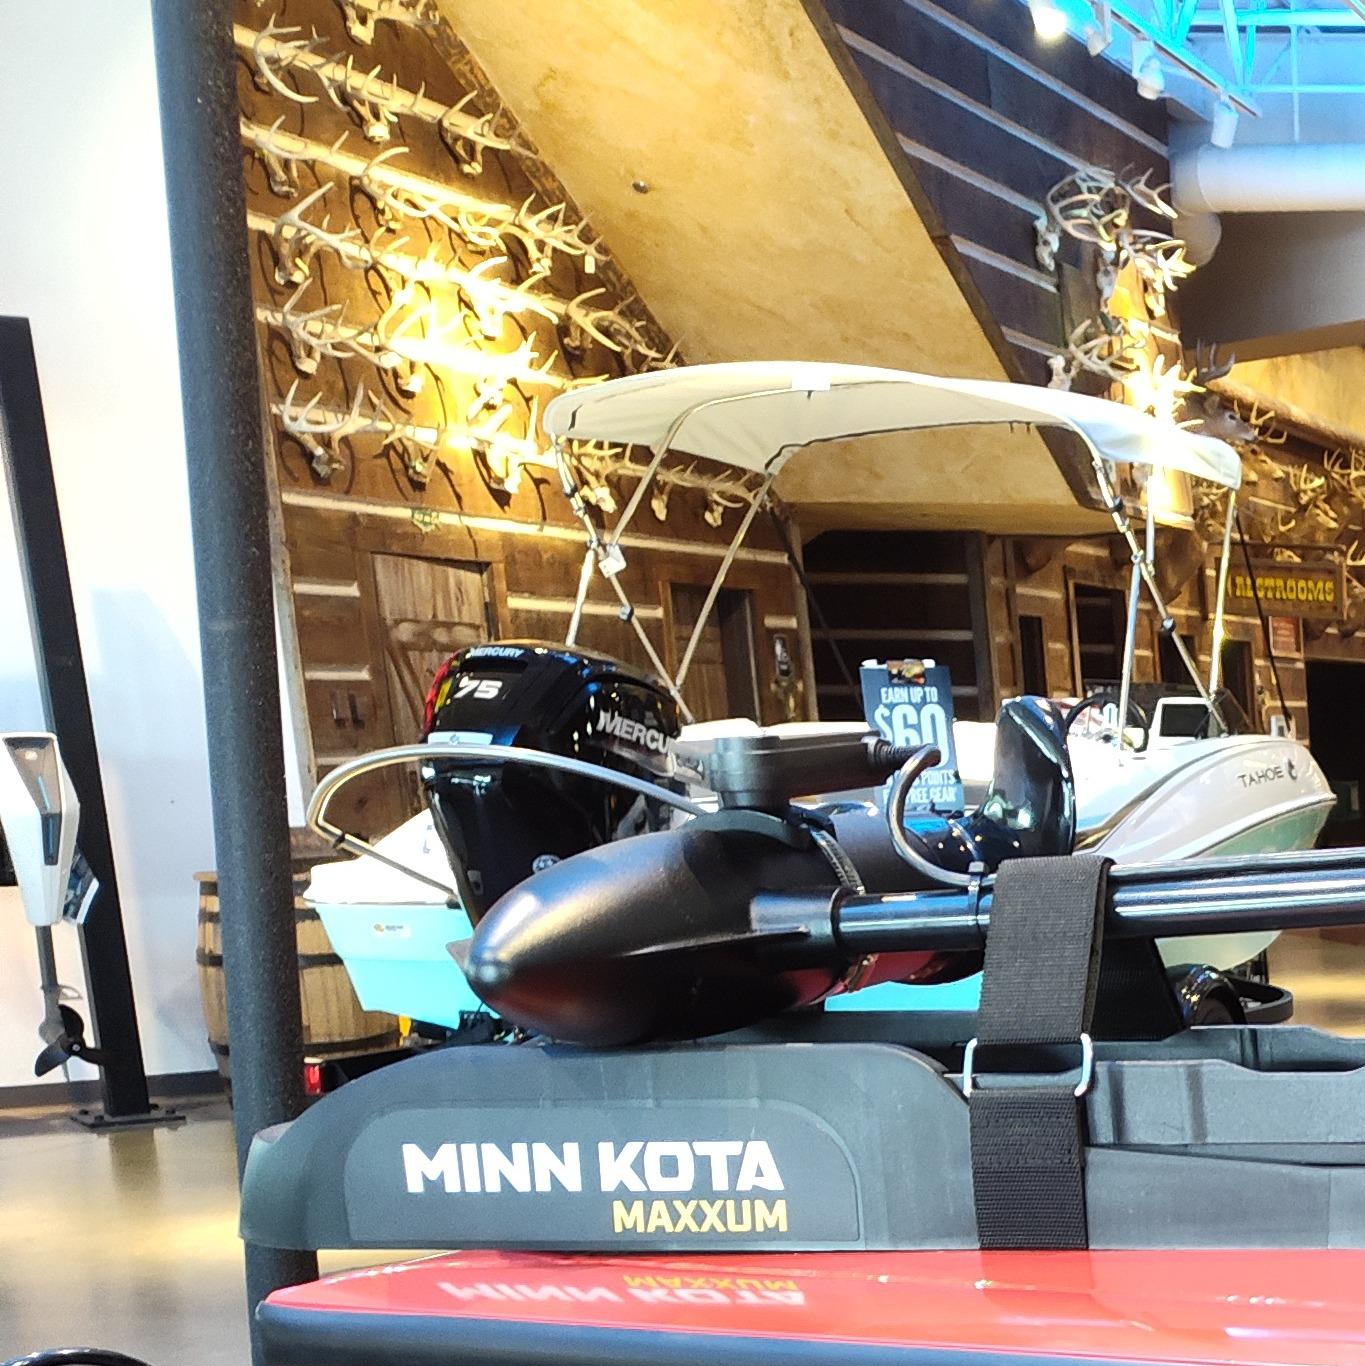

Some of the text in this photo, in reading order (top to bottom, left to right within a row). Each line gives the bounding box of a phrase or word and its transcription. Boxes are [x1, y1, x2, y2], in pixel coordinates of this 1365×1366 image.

[453, 676, 503, 700] 75
[880, 686, 938, 704] EARN UP TO
[596, 709, 677, 754] MERCU
[874, 703, 950, 768] $60
[1238, 766, 1284, 789] TAHOE
[906, 786, 929, 803] REE
[401, 1139, 786, 1195] MINN KOTA
[613, 1198, 789, 1234] MAXXUM
